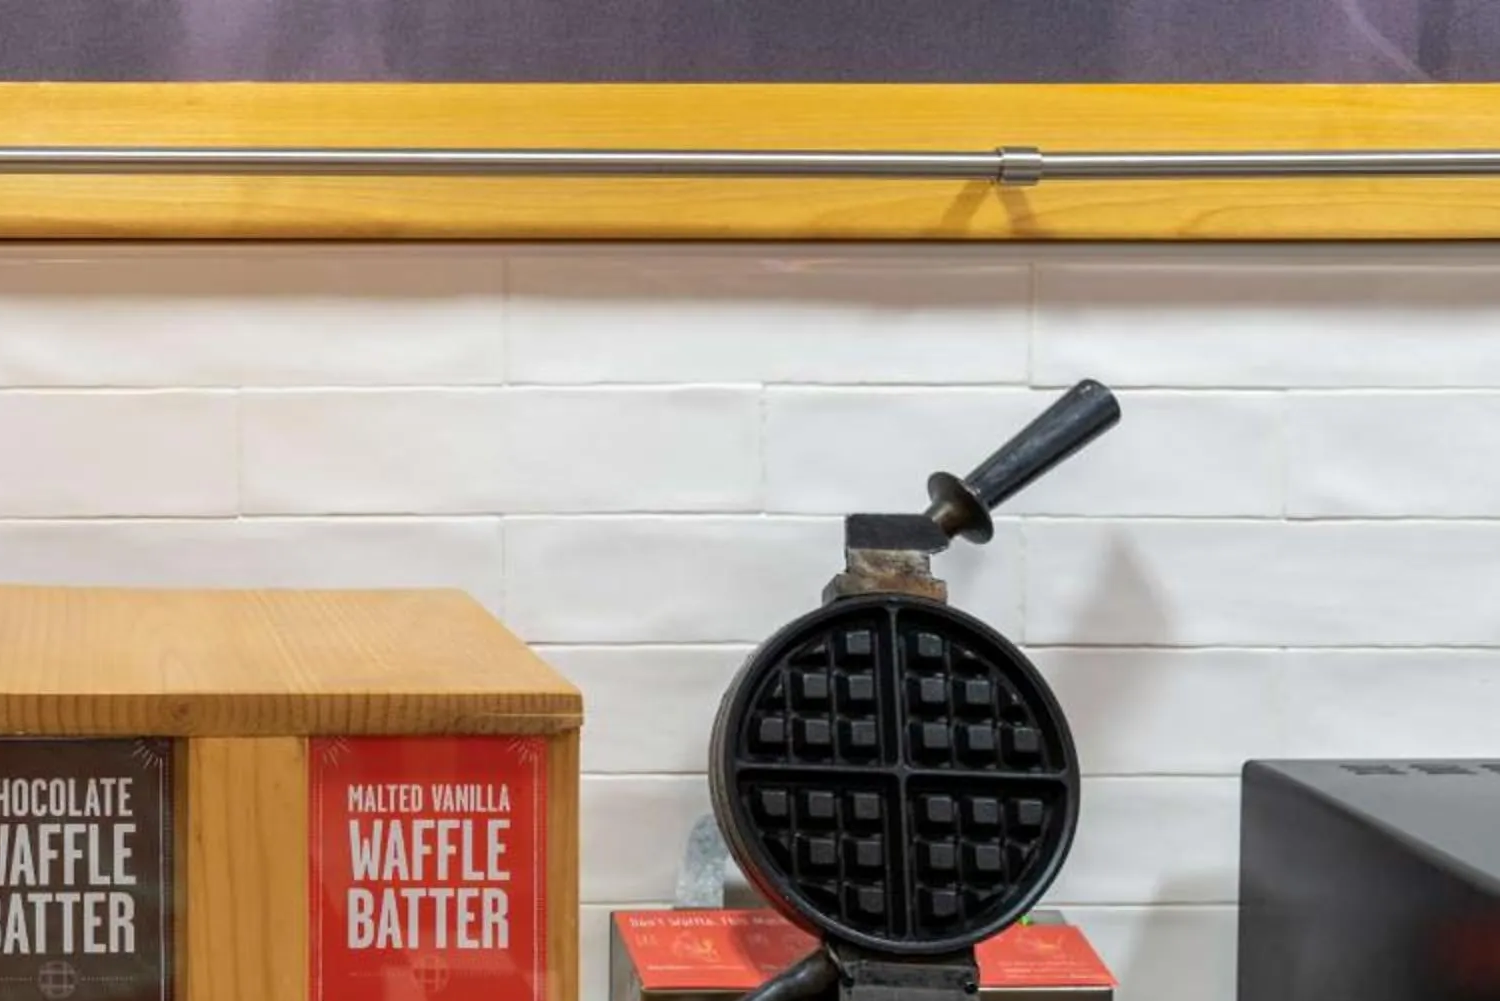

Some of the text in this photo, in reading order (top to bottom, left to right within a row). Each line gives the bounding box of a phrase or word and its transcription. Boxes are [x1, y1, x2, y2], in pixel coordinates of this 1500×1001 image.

[348, 784, 511, 812] MALTED VANILLA
[348, 819, 511, 881] WAFFLE
[347, 887, 509, 950] BATTER
